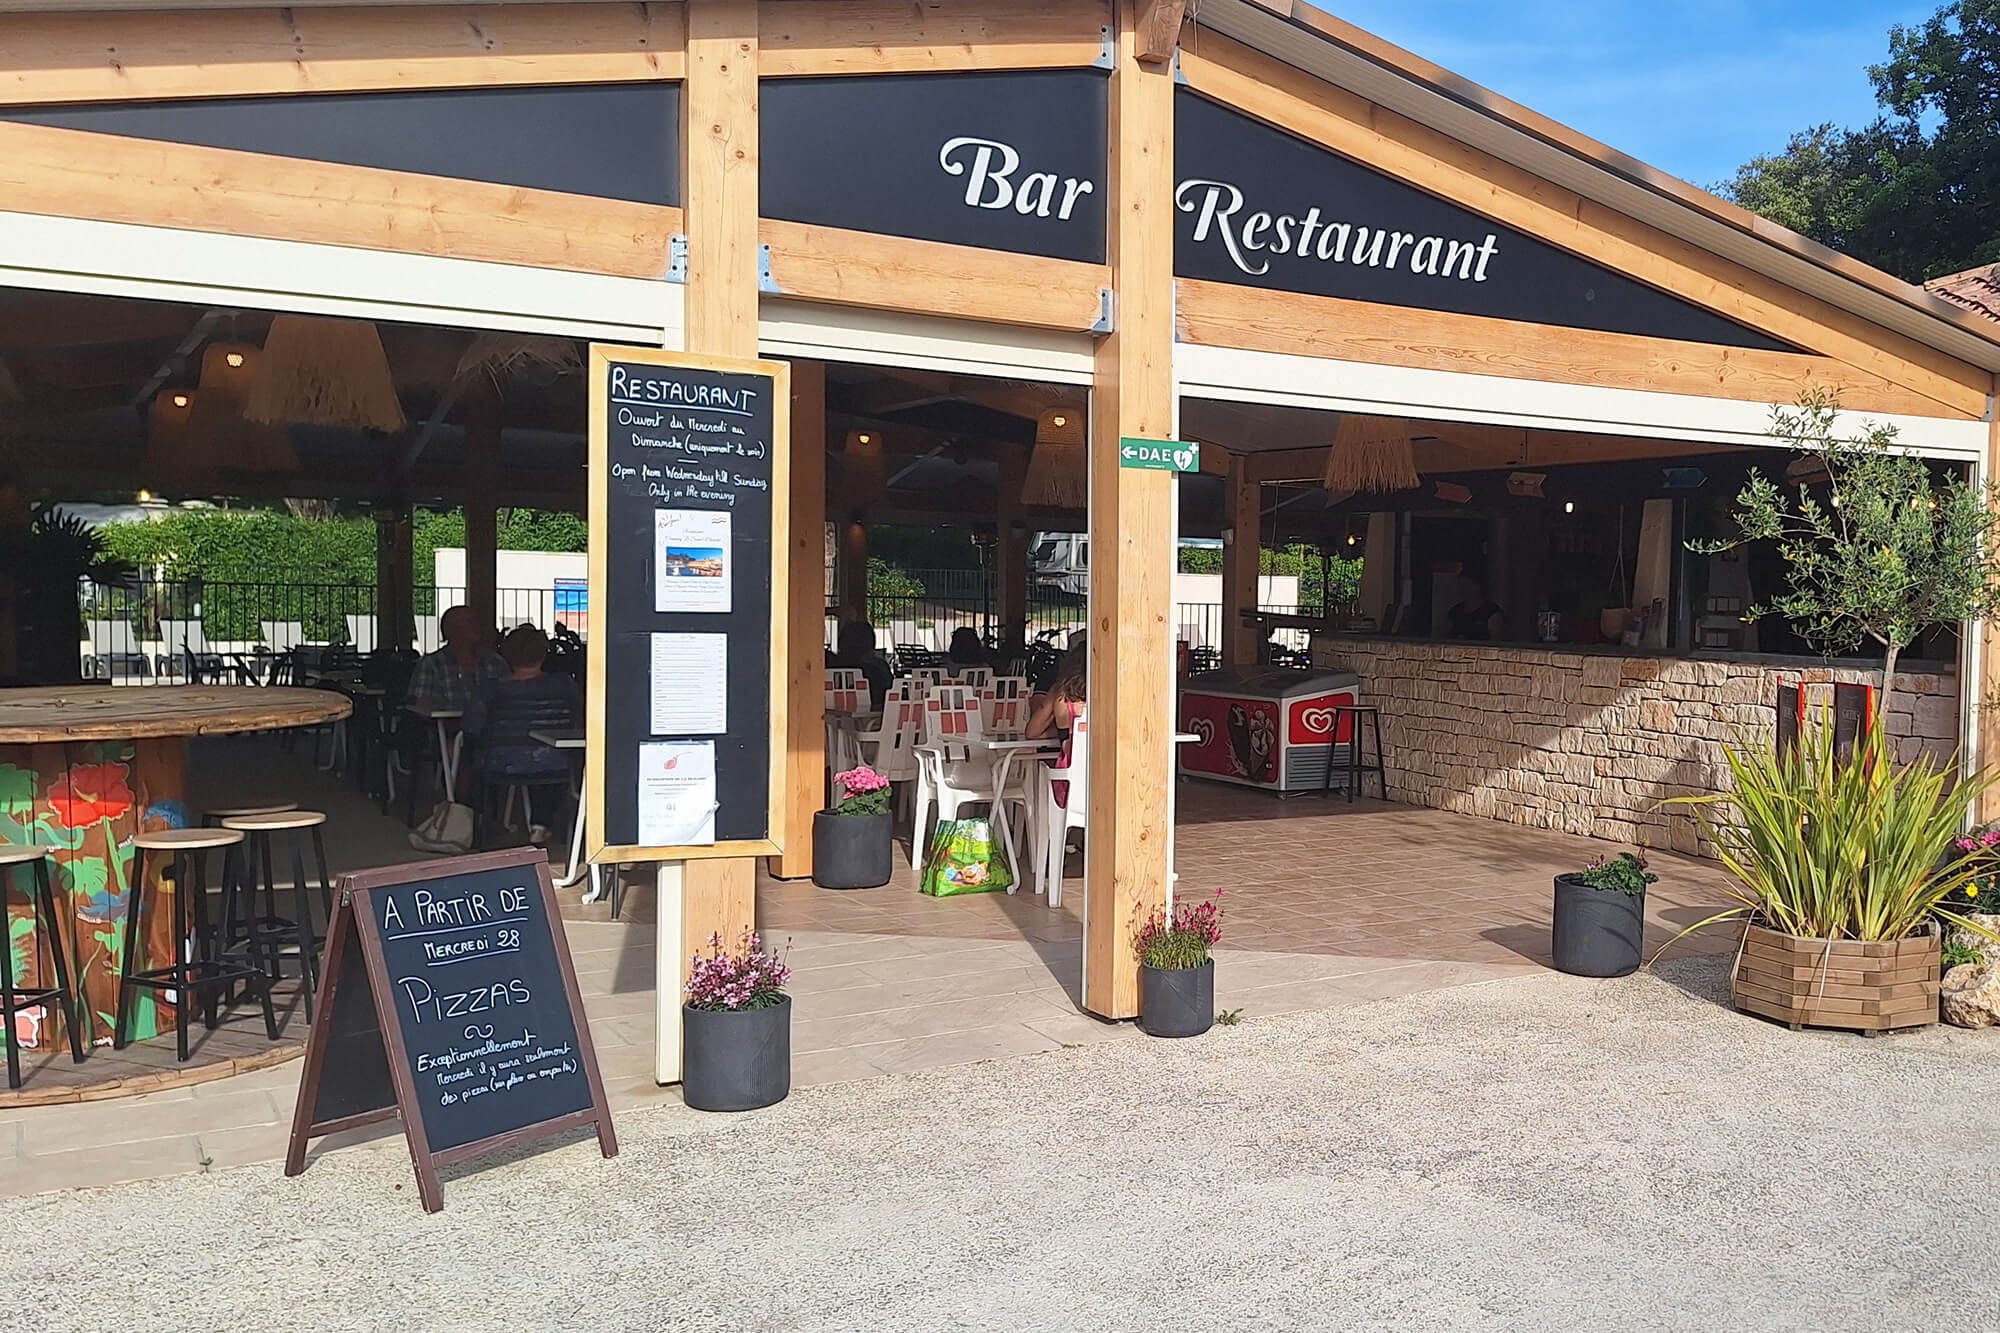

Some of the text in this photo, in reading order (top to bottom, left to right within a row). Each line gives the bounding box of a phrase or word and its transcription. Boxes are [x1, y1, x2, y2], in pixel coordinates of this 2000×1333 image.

[939, 136, 1094, 222] Bar
[1175, 179, 1500, 283] Restaurant
[611, 366, 757, 411] RESTAURANT
[618, 407, 745, 435] Ouvert du Mercredi au
[631, 432, 684, 450] Dimanche
[735, 442, 745, 456] le
[1139, 446, 1171, 462] DAE
[611, 463, 636, 480] Open
[641, 464, 662, 481] from
[665, 465, 715, 487] Wednesday
[733, 474, 769, 491] Sunday
[648, 482, 671, 502] Only
[673, 486, 683, 497] in
[700, 489, 736, 506] evening
[384, 887, 530, 930] A PARTIR DE
[423, 929, 521, 960] MERCREDI 28
[397, 976, 531, 1024] PIZZAS
[436, 1066, 475, 1087] Mercredi
[476, 1061, 487, 1075] il
[489, 1065, 497, 1078] y
[497, 1058, 521, 1070] aura
[440, 1091, 459, 1106] des
